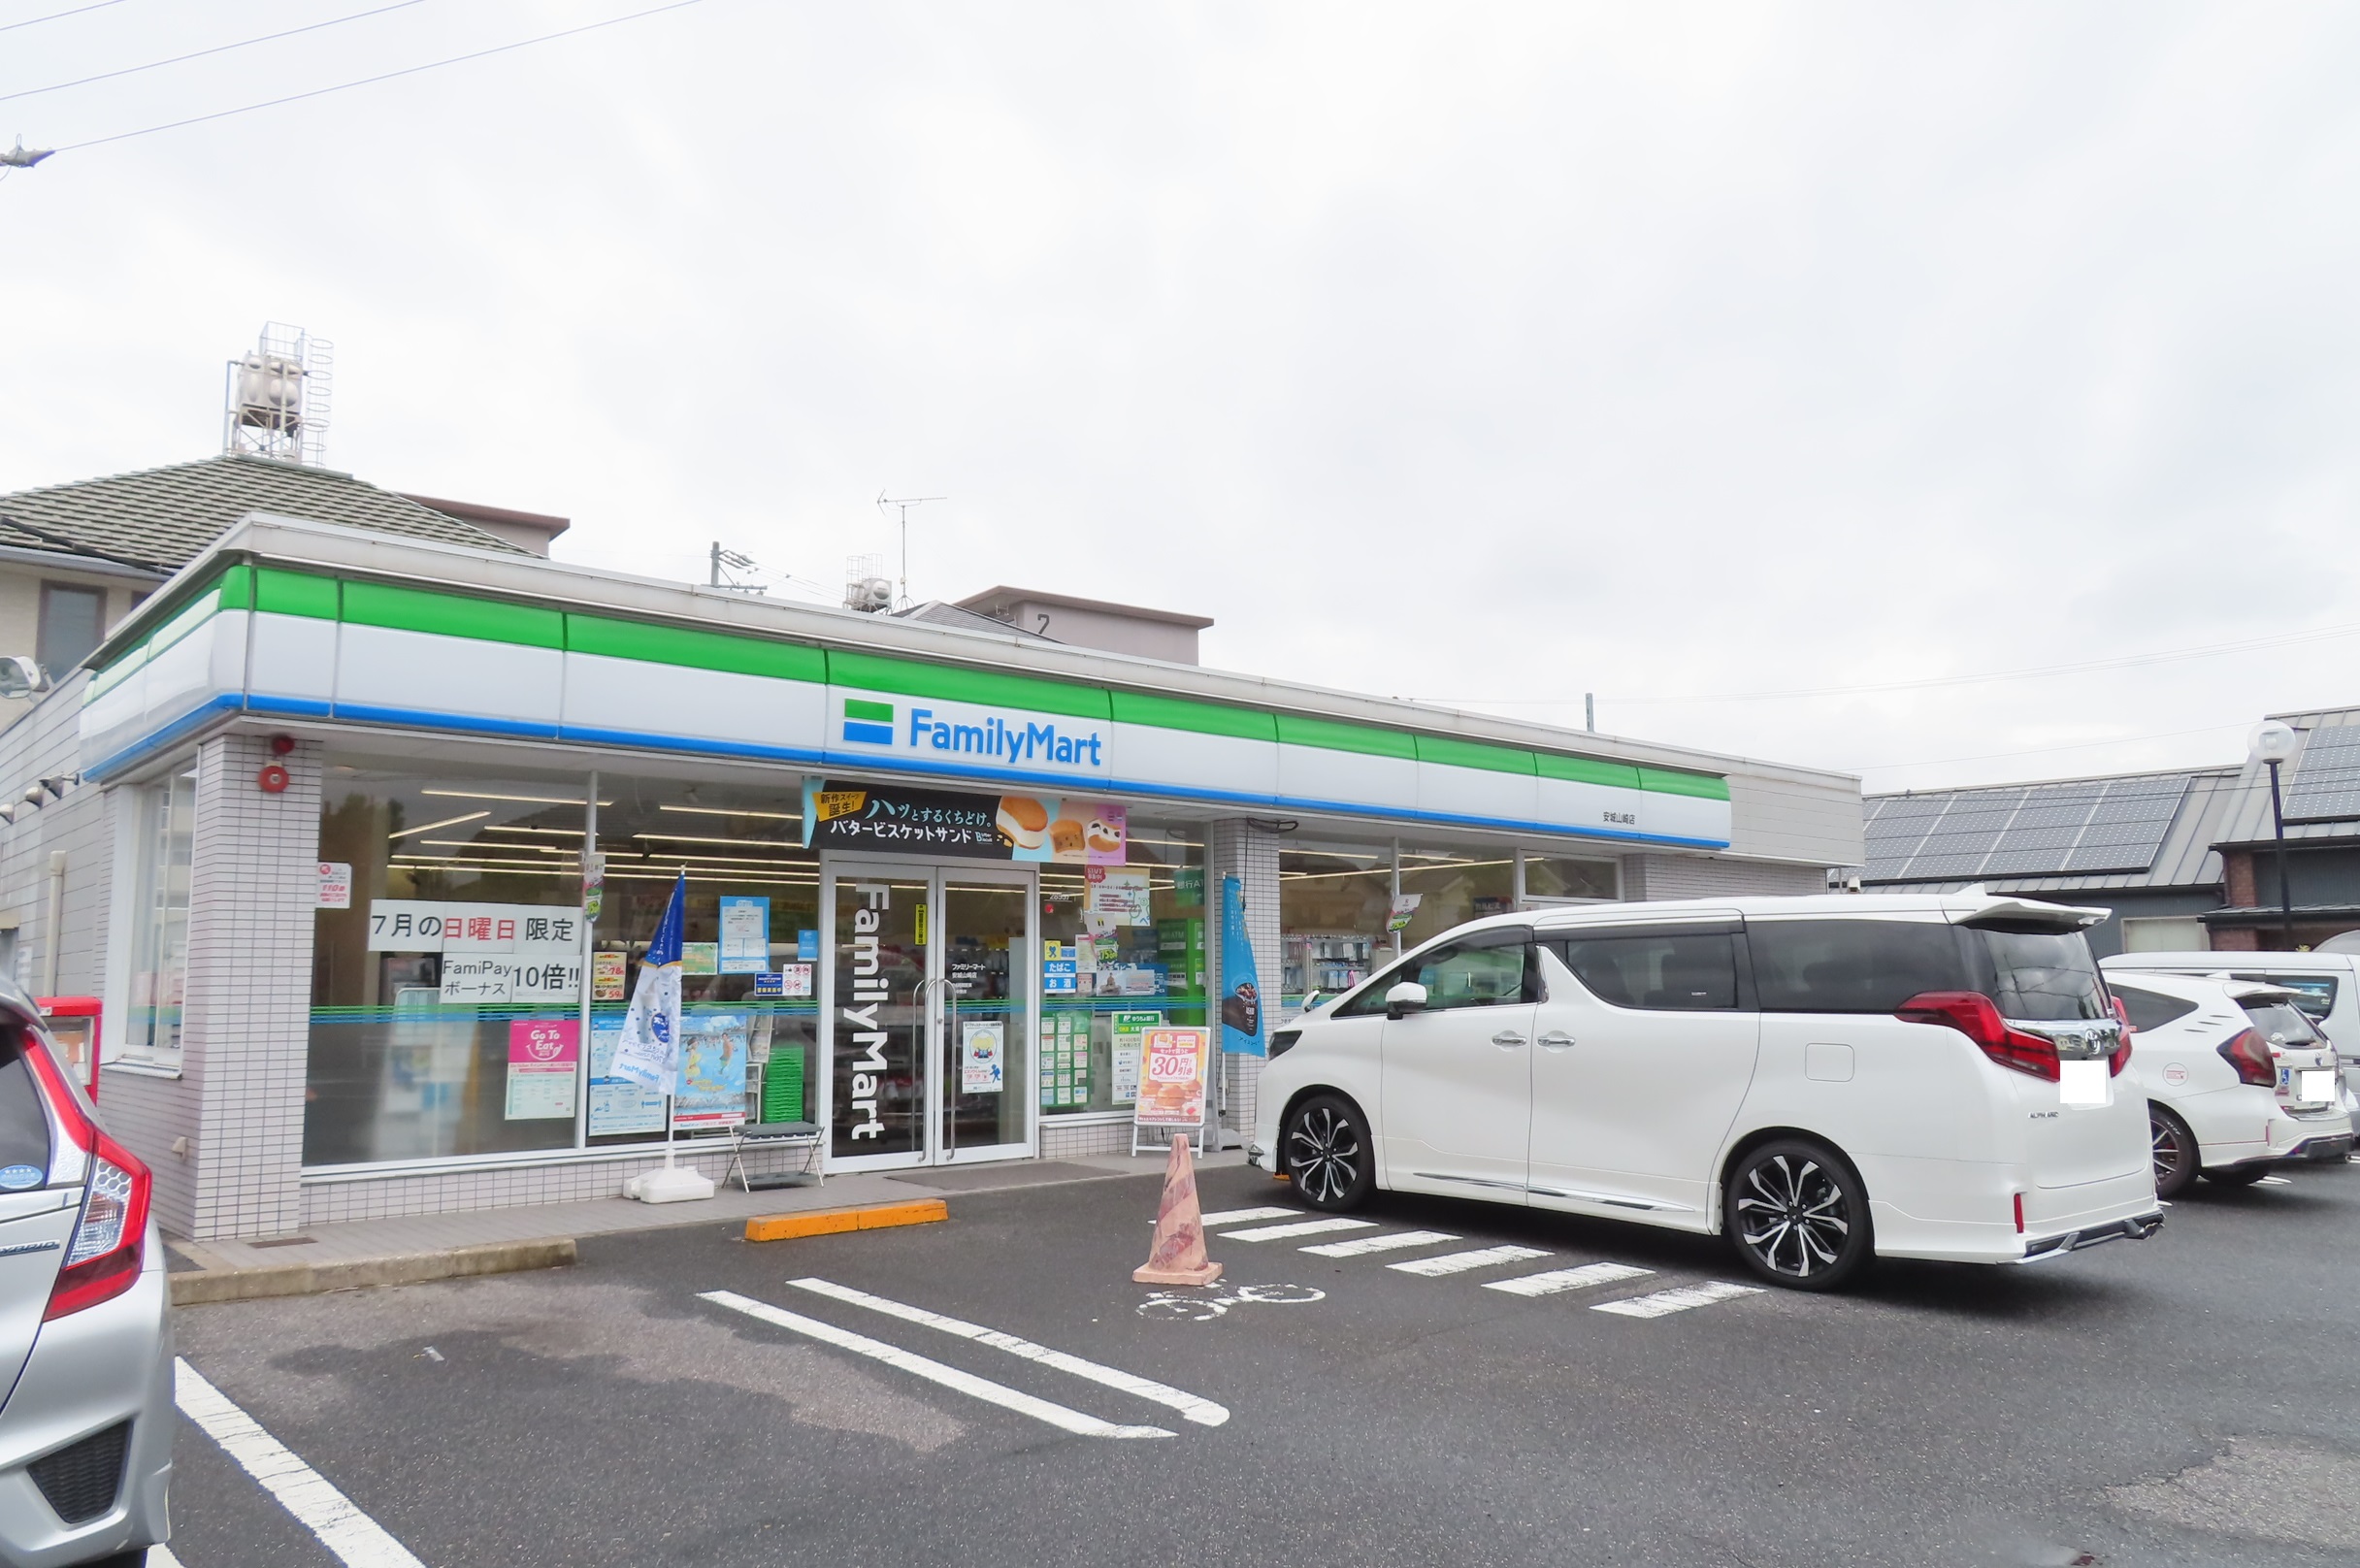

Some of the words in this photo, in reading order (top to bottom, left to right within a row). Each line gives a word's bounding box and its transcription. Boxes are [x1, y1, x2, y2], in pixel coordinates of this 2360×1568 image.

[910, 707, 1101, 766] FamilyMart
[865, 799, 992, 828] ハッとするくちどけ。
[830, 820, 972, 844] バタービスケットサンド
[442, 960, 512, 978] FamiPay
[1048, 962, 1071, 972] たばこ
[444, 981, 507, 996] ボーナス
[842, 884, 890, 1141] FamilyMart
[530, 1029, 545, 1040] Go
[548, 1029, 560, 1040] To
[536, 1040, 554, 1051] Eat
[1152, 1056, 1179, 1076] 30
